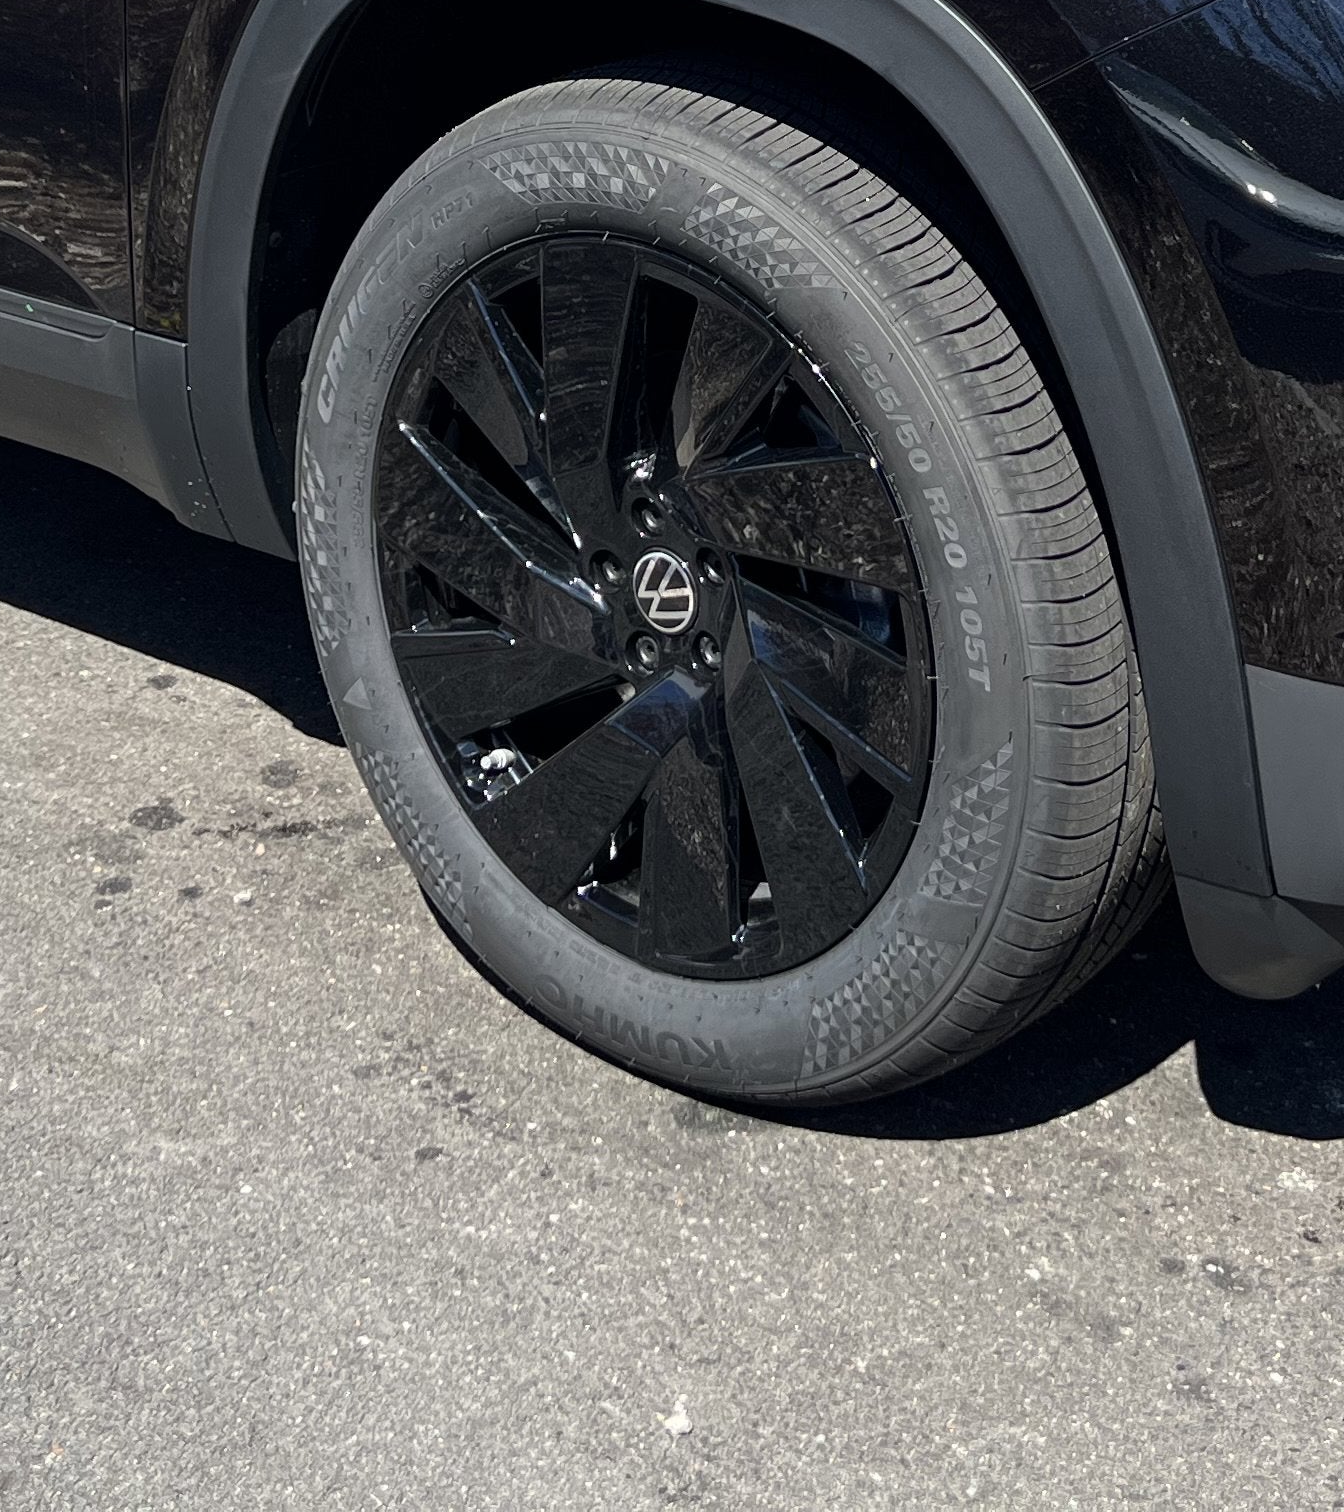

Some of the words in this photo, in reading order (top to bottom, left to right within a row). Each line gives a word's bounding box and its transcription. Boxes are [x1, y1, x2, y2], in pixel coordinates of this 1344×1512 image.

[317, 207, 424, 425] CRUGEN
[430, 191, 474, 230] HP71
[843, 342, 931, 472] 255/50
[924, 489, 967, 568] R20
[961, 586, 993, 691] 105T
[533, 976, 731, 1070] KUMHO
